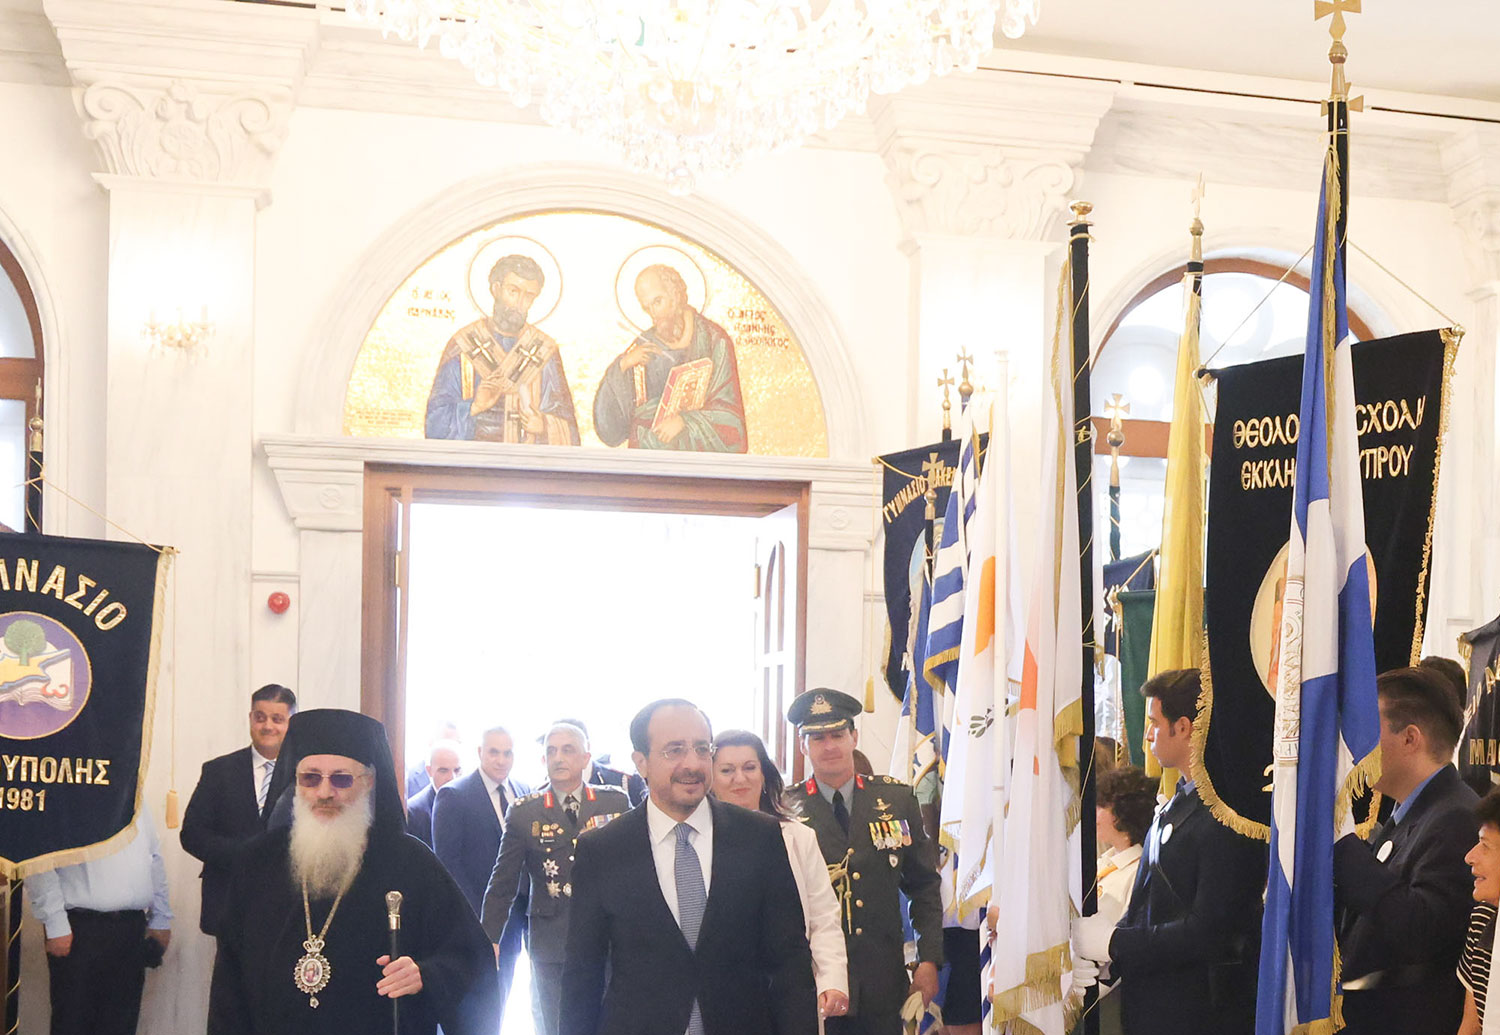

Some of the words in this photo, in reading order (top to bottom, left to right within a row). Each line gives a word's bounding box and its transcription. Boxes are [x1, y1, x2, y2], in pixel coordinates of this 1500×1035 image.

[1232, 413, 1300, 449] ΘΕΟΛΟ
[1240, 457, 1297, 491] ΕΚΚΛΗ
[0, 787, 47, 812] 1981
